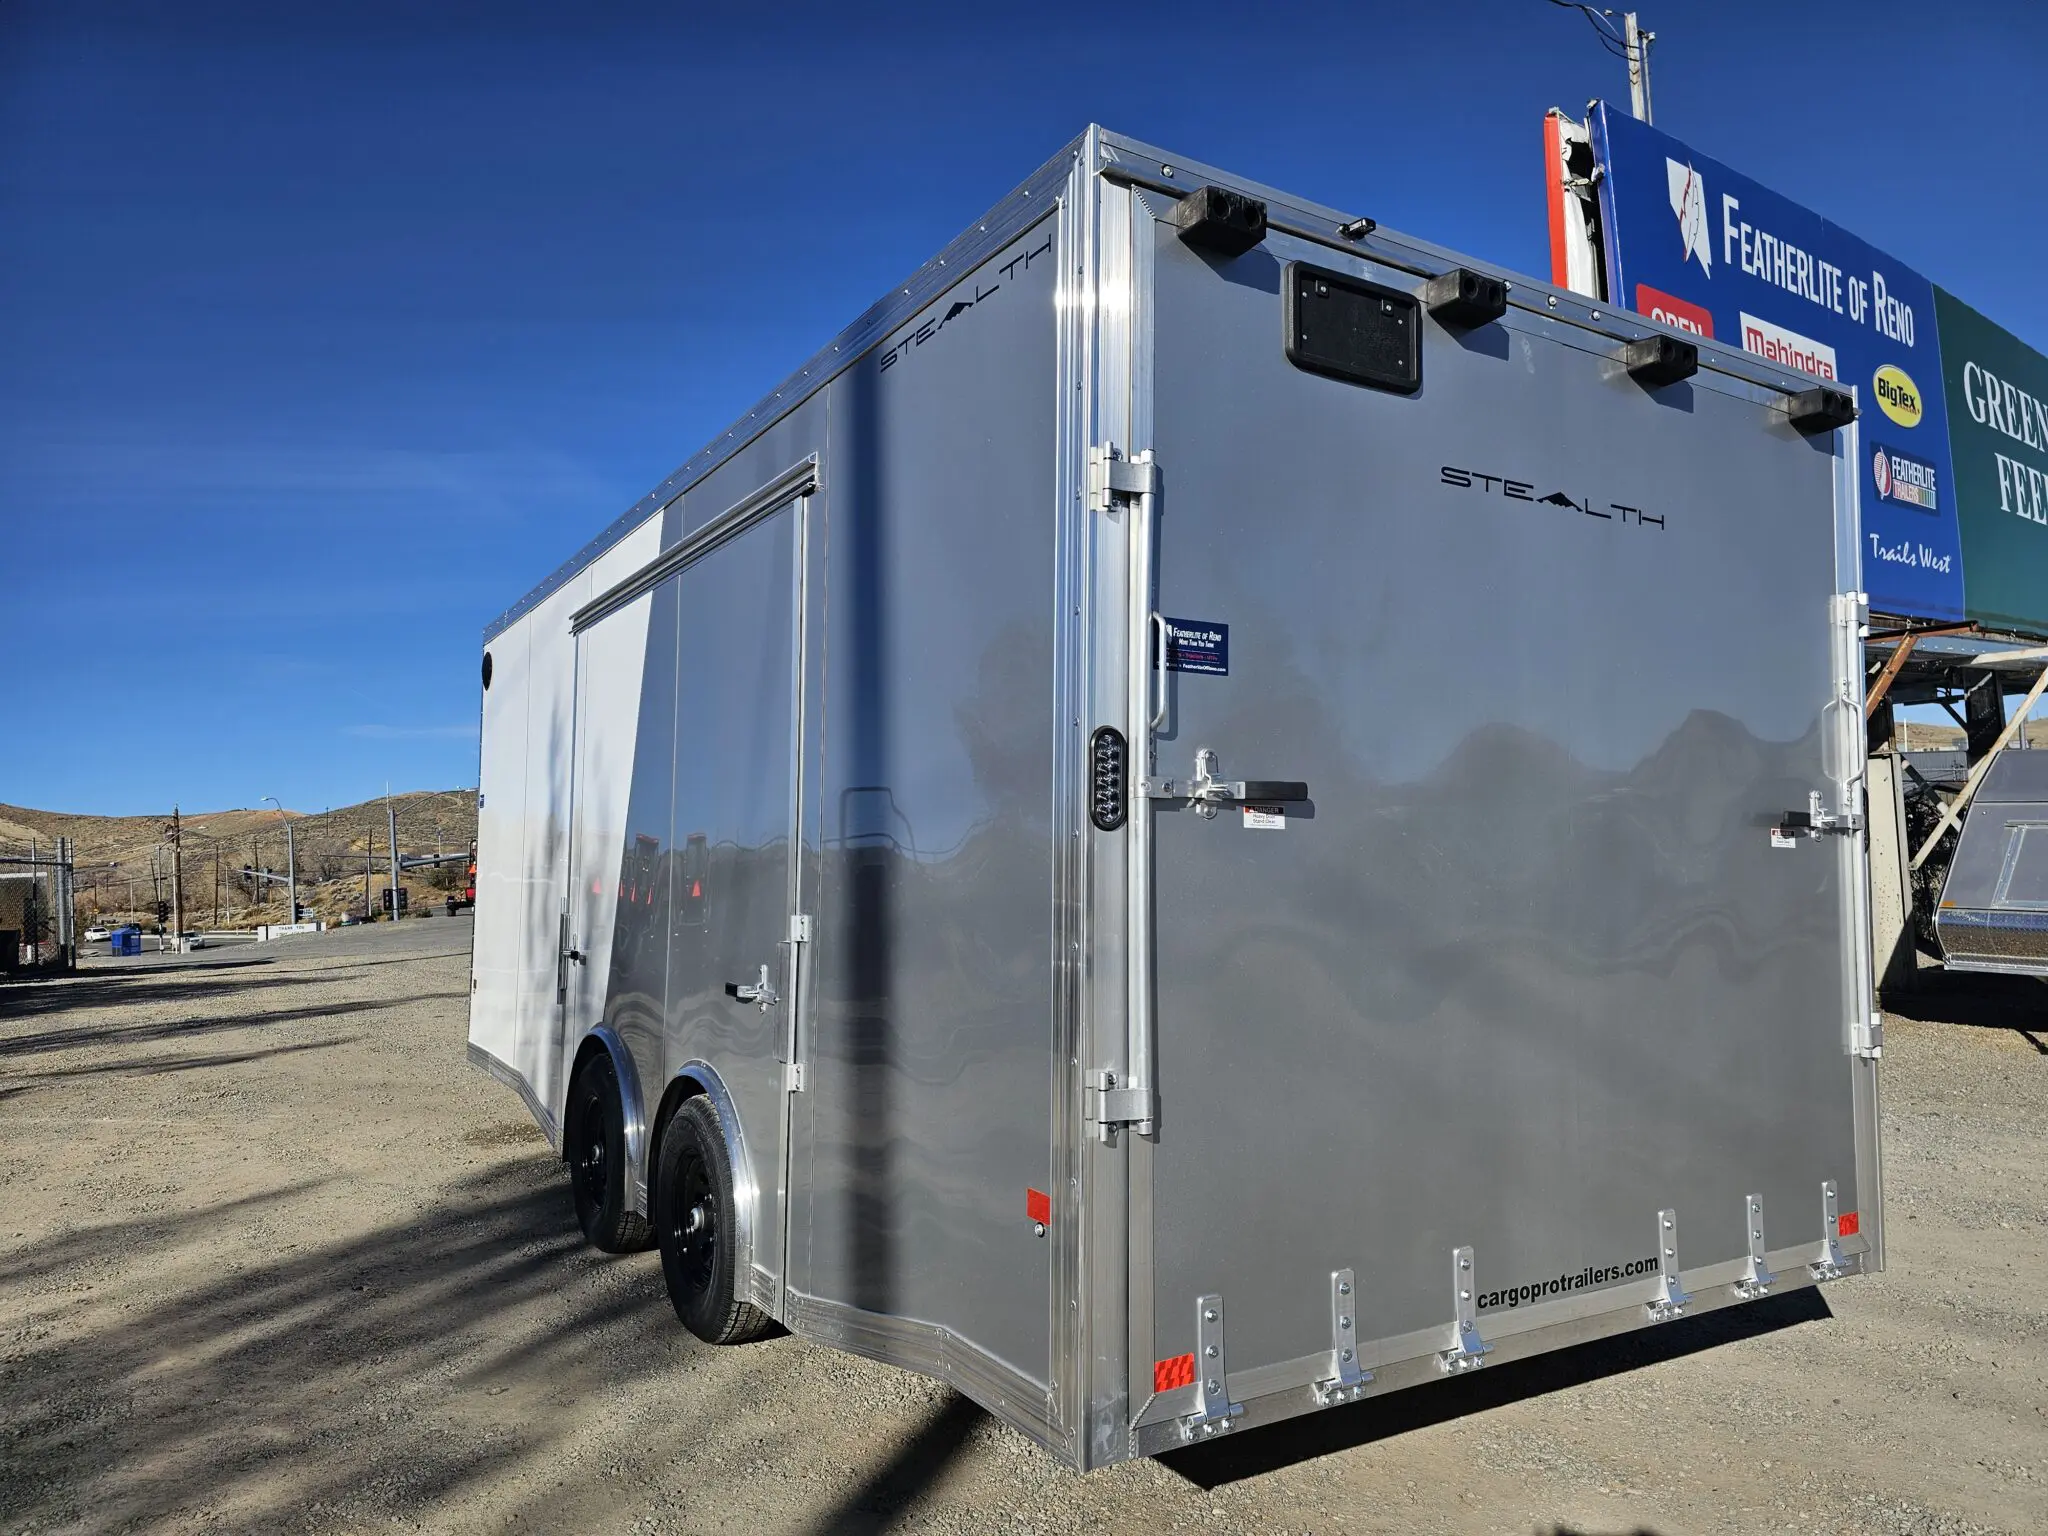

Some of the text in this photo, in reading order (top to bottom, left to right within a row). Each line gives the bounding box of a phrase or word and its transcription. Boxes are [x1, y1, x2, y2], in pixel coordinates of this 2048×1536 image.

[1722, 193, 1915, 348] FEATHERLITE OF RENO
[1746, 325, 1835, 380] Mahindra
[1440, 465, 1665, 531] STEALTH
[1891, 455, 1937, 491] FEATHERLITE
[1894, 480, 1920, 503] TRAILERS
[1994, 452, 2048, 526] FEE
[1869, 532, 1951, 573] Trails West
[1477, 1256, 1659, 1309] cargoprotrailers.com
